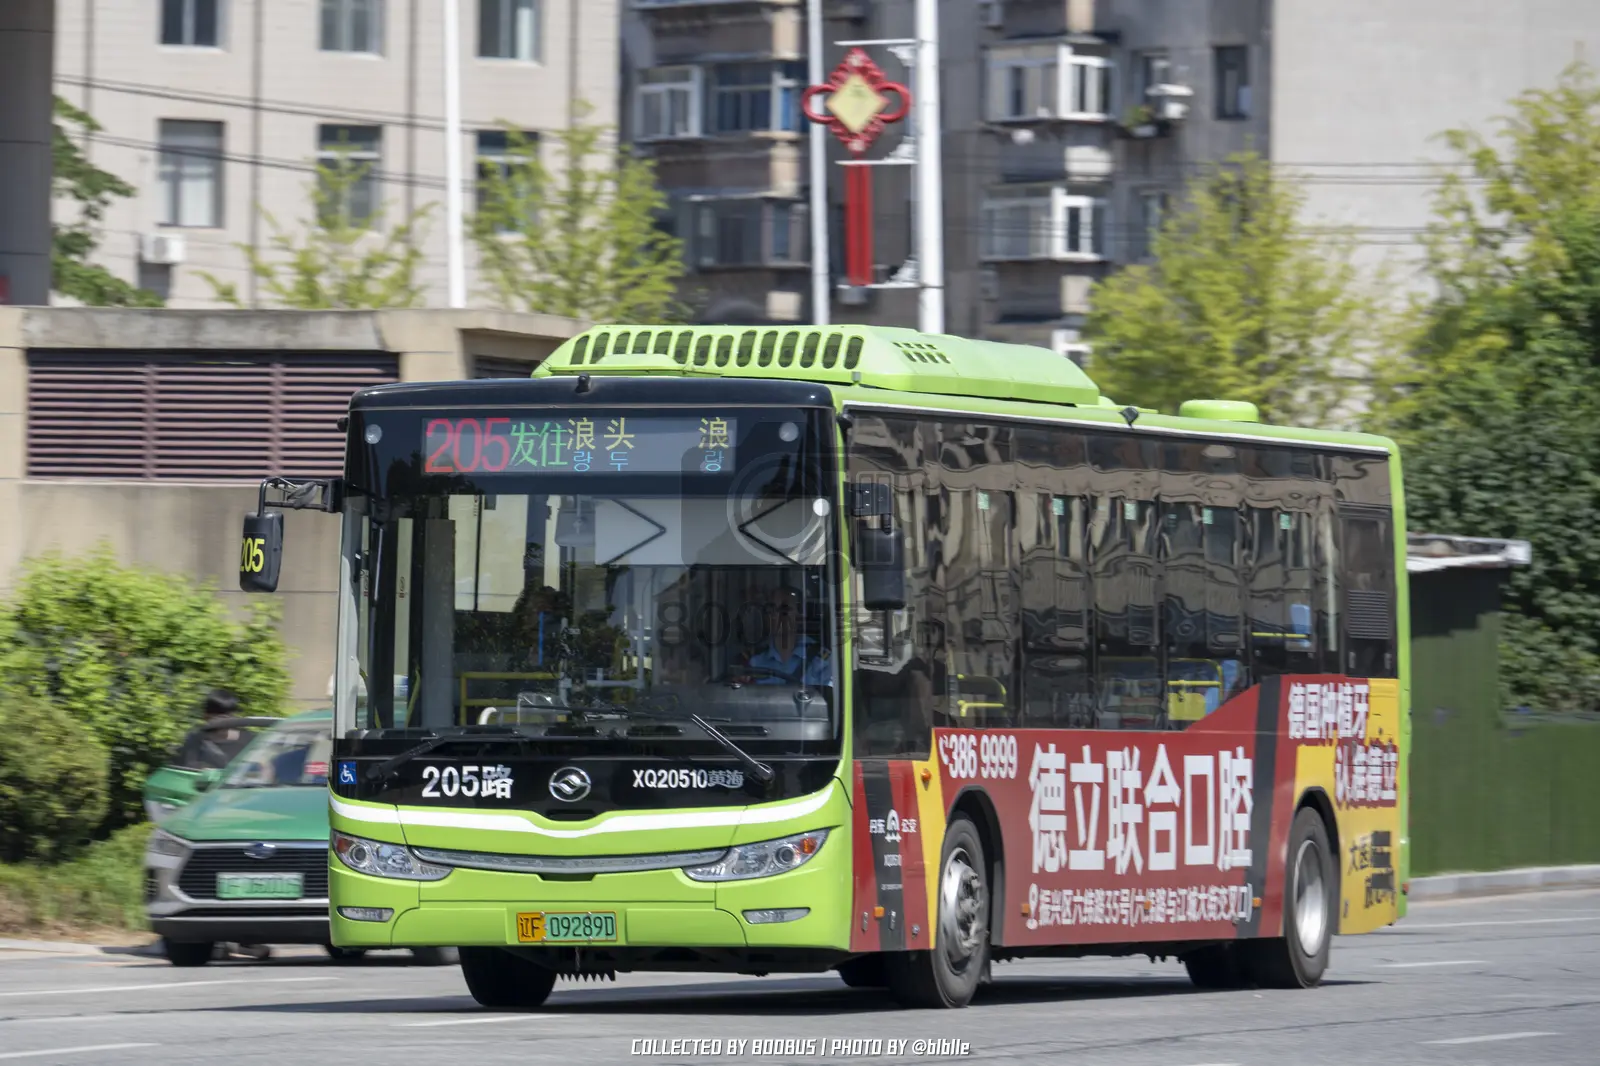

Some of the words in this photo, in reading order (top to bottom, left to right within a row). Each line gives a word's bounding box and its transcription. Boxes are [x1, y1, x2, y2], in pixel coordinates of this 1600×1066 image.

[424, 417, 510, 473] 205
[567, 417, 635, 451] 浪头
[698, 416, 729, 450] 浪
[949, 734, 977, 779] 386
[980, 734, 1018, 779] 9999
[421, 764, 515, 799] 205路
[632, 768, 708, 789] XQ20510
[1028, 742, 1254, 875] 德立联合口腔
[520, 917, 541, 938] 辽F
[549, 916, 615, 938] 09289D
